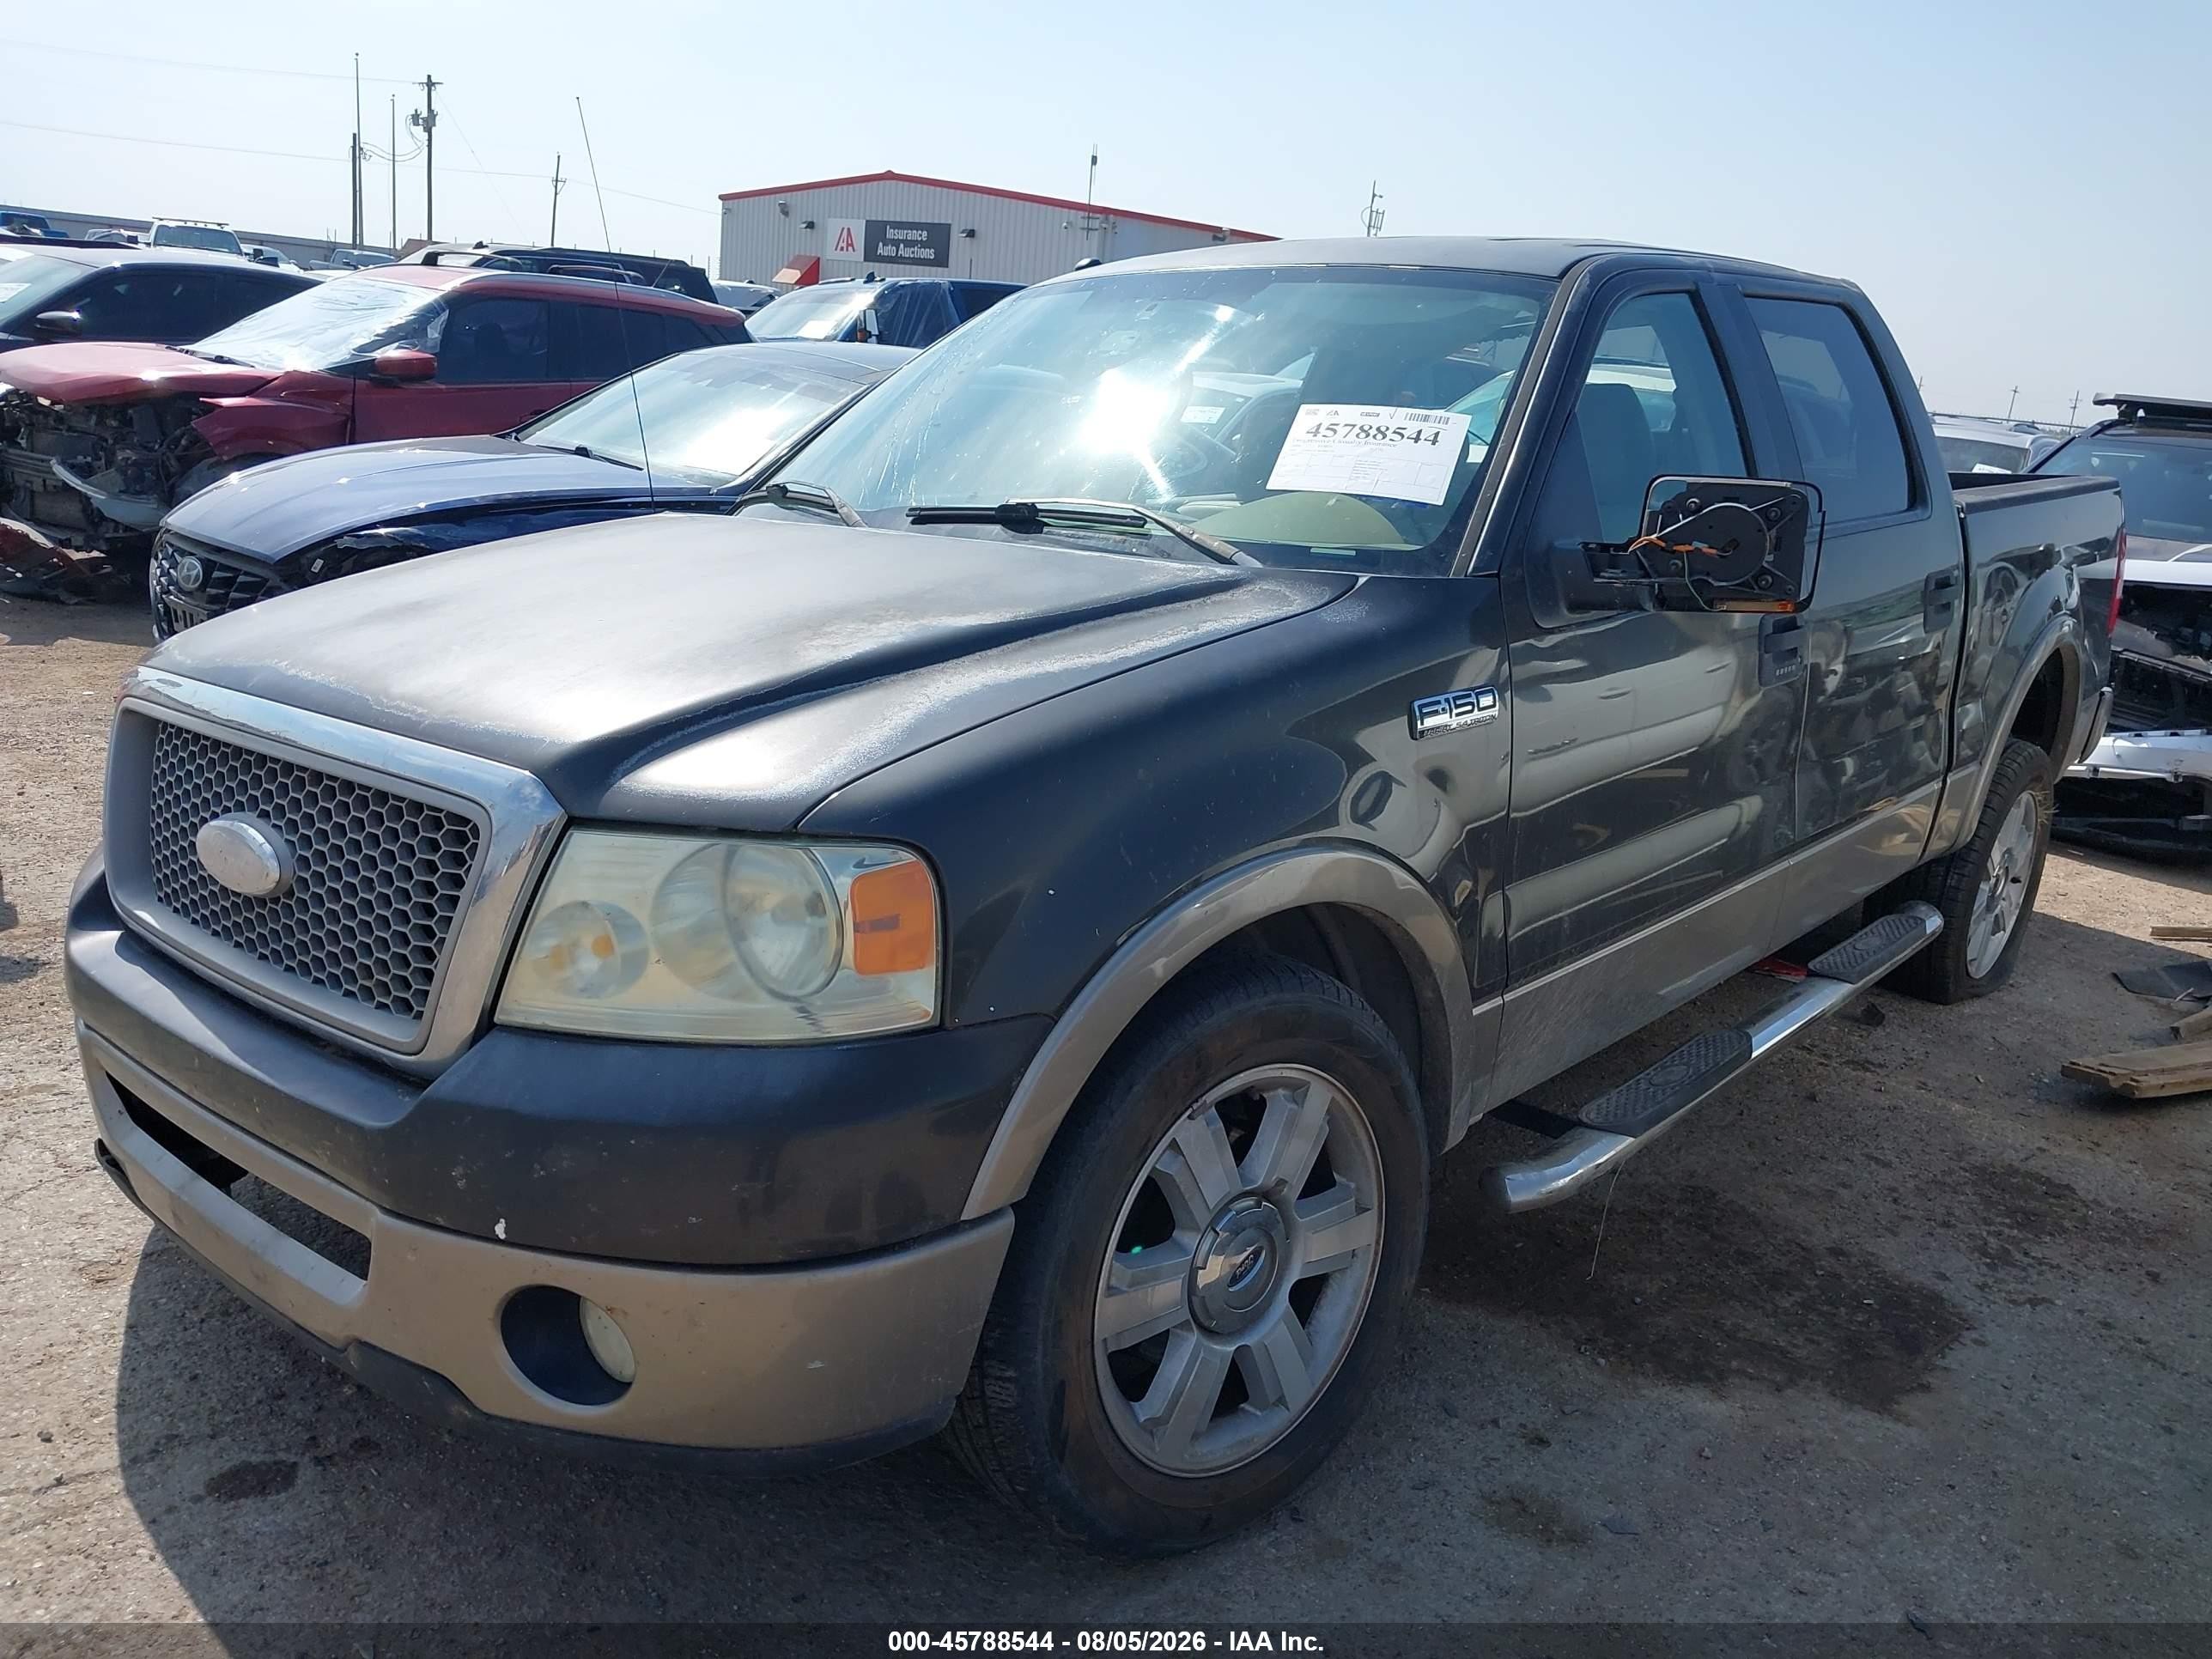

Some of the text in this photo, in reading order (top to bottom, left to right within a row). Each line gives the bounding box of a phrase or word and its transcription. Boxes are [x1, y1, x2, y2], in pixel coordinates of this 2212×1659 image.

[885, 225, 927, 241] Insurance
[877, 241, 935, 259] Auto Auctions
[1305, 422, 1440, 447] 45788544
